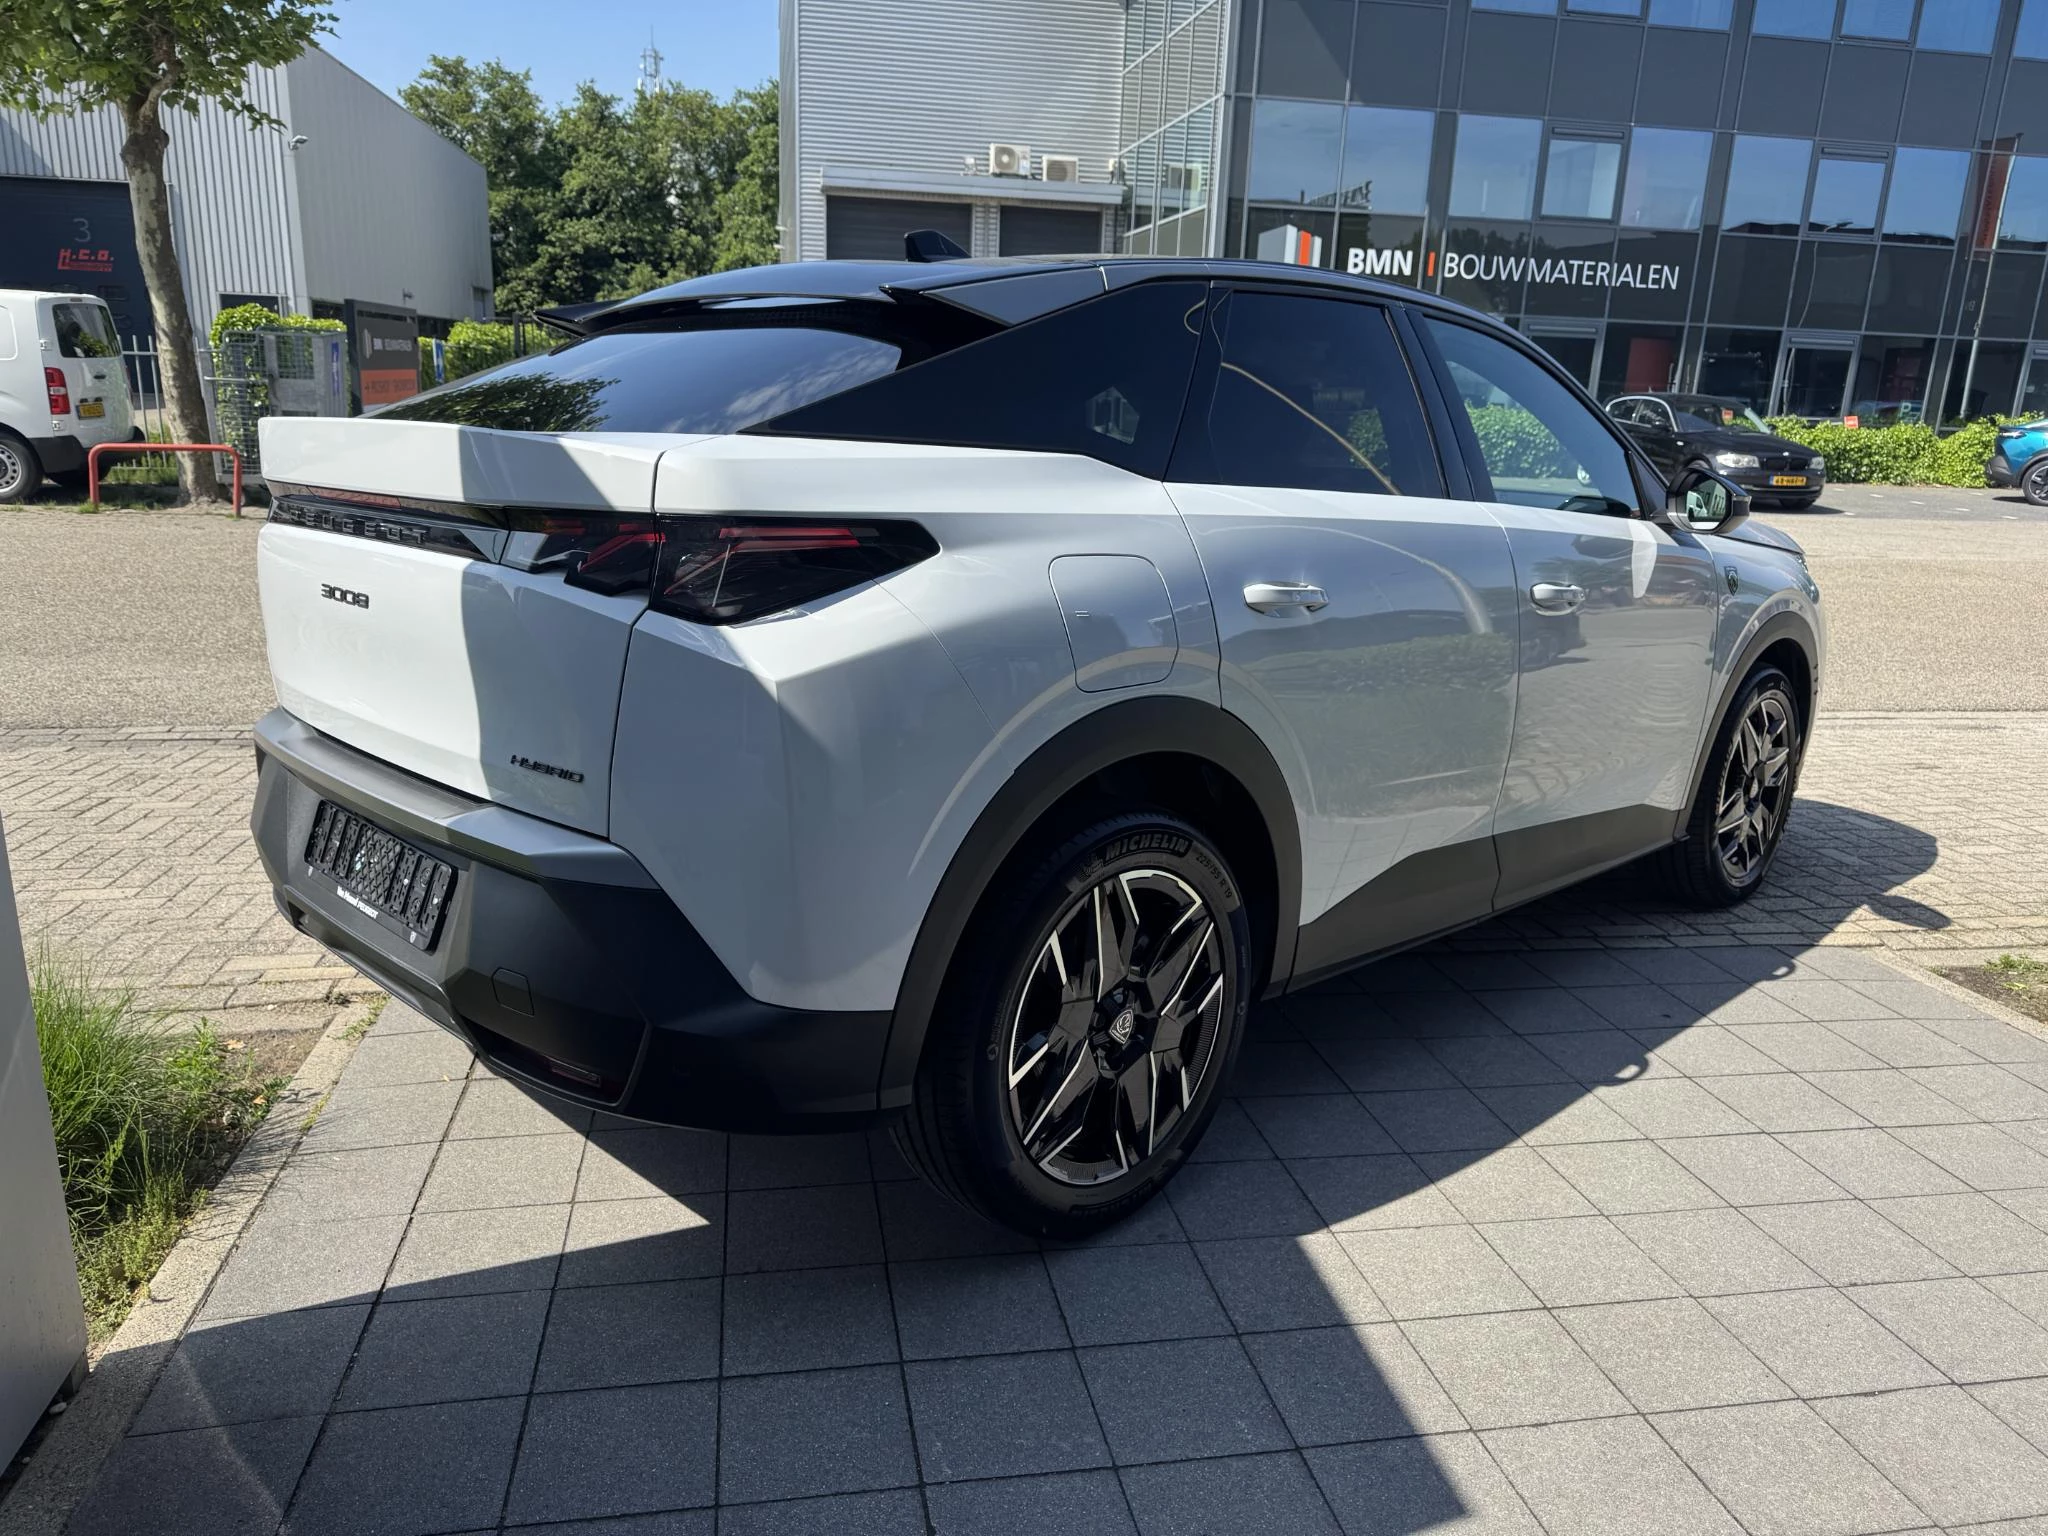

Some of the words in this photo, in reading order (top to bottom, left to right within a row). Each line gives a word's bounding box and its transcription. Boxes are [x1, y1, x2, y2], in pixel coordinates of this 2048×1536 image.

[73, 217, 91, 242] 3
[1347, 247, 1414, 277] BMN
[1443, 252, 1680, 291] BOUWMATERIALEN
[289, 508, 428, 544] PEUGEOT
[321, 582, 370, 610] 3008
[510, 754, 585, 783] HYBRID
[1105, 834, 1189, 861] MICHELIN
